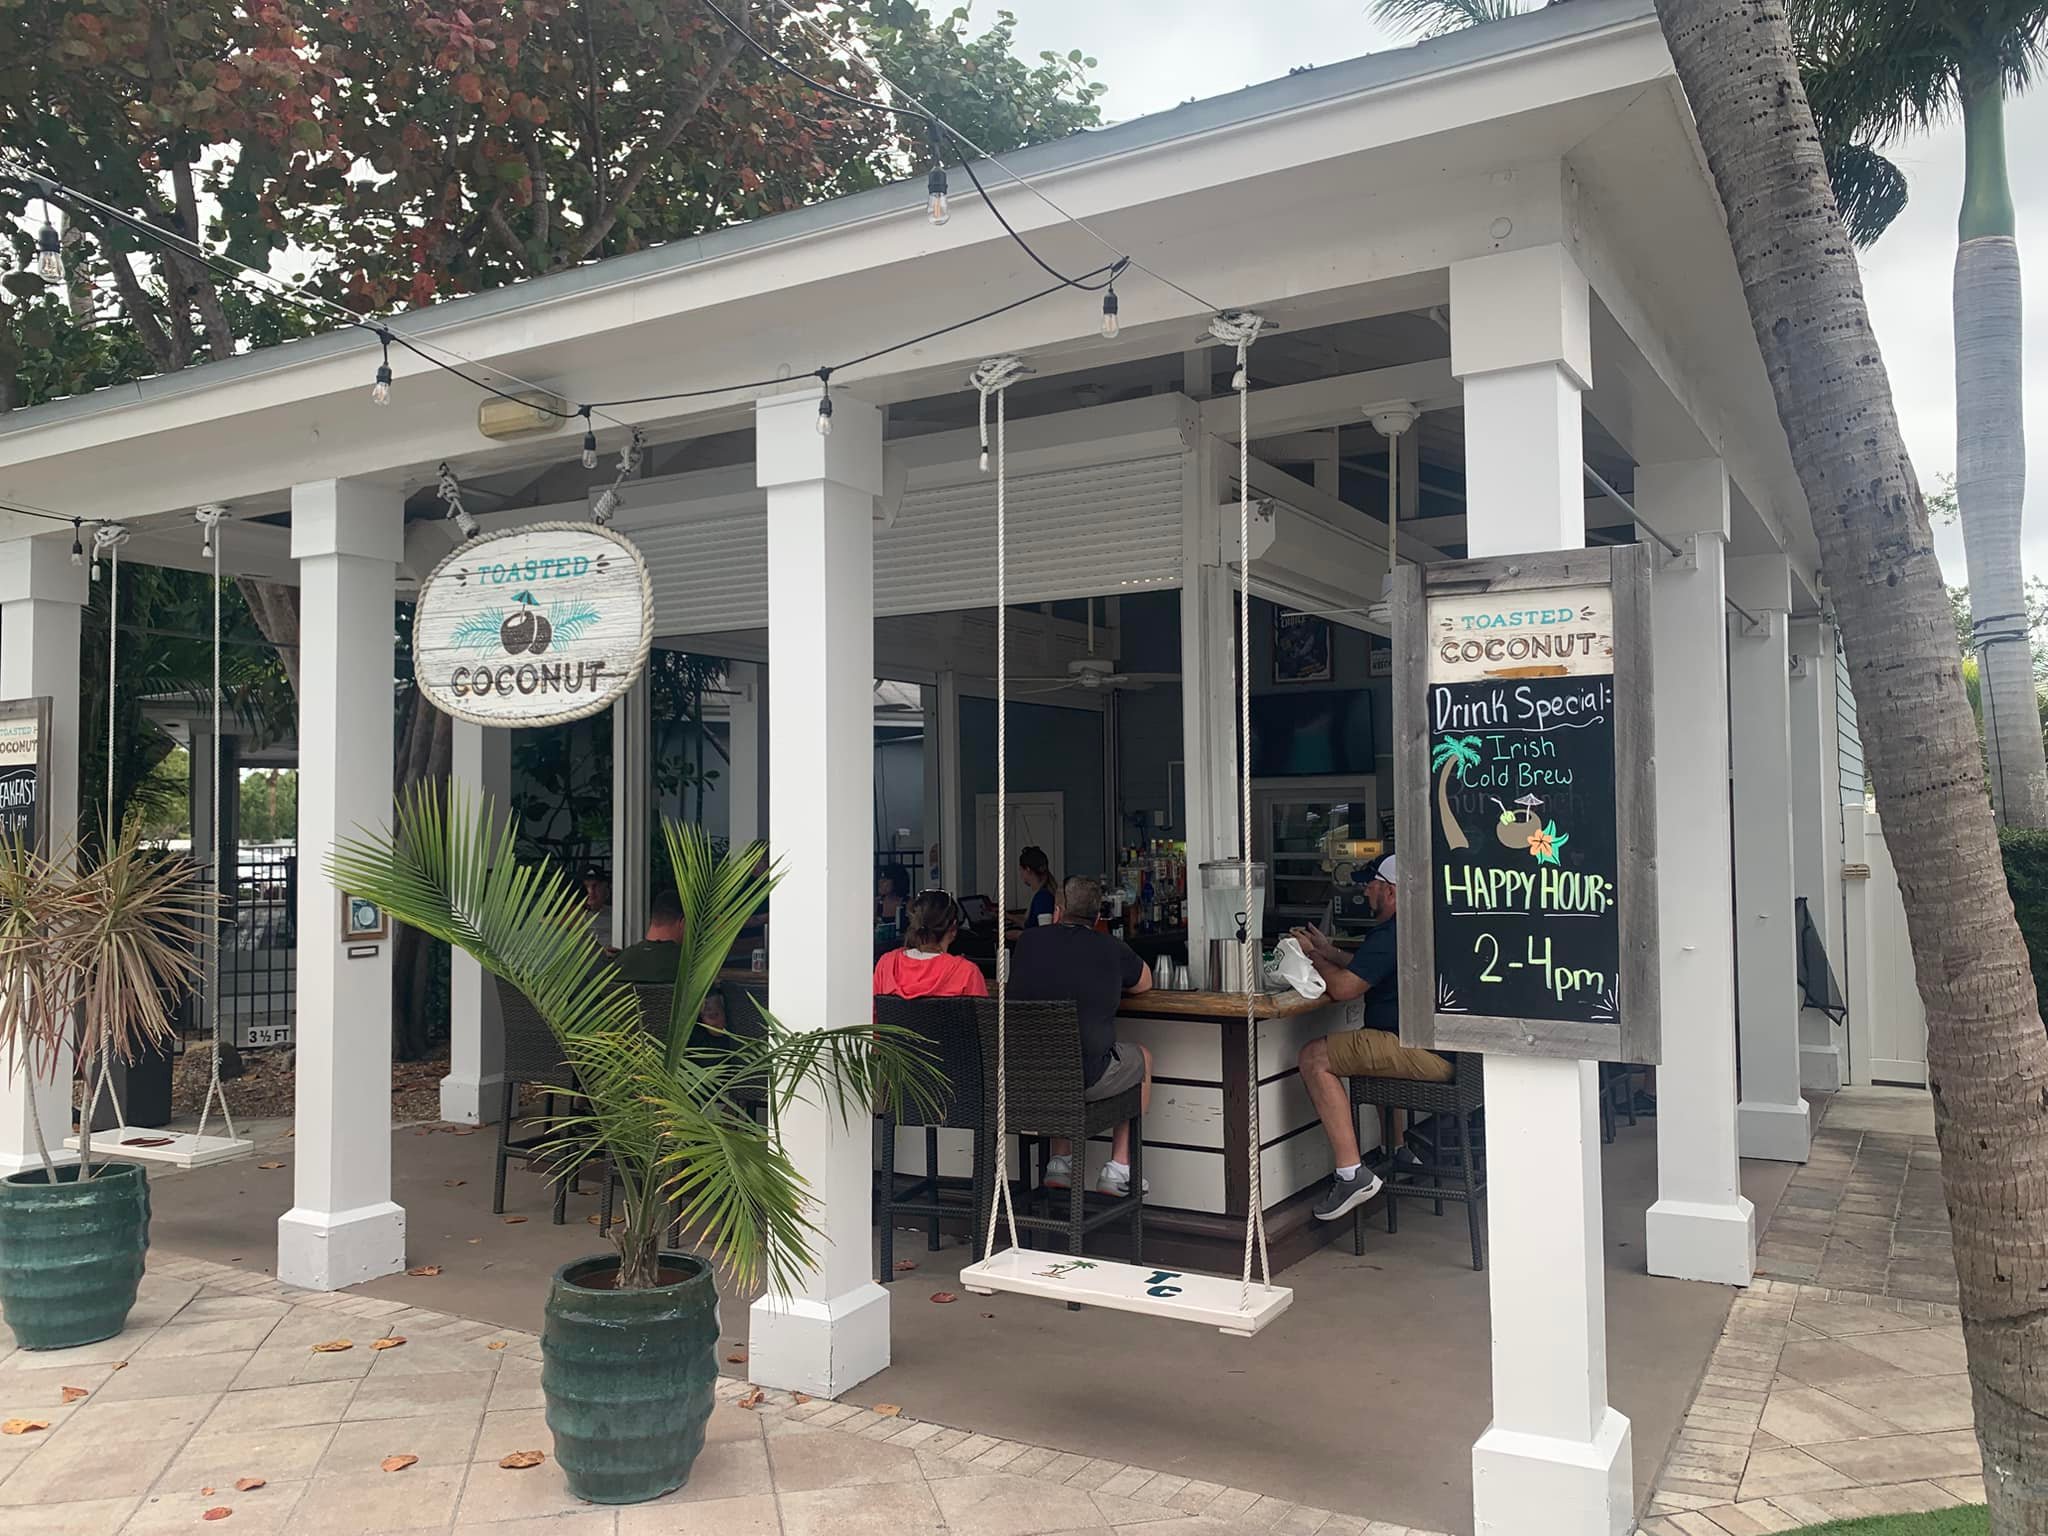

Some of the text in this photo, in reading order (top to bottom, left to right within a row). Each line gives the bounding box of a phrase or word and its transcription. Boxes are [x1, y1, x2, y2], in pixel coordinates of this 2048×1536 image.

[478, 556, 589, 585] TOASTED
[1461, 607, 1574, 631] TOASTED
[1440, 632, 1597, 664] COCONUT
[450, 660, 606, 698] COCONUT
[1434, 682, 1613, 731] Drink Special:
[1486, 734, 1556, 761] Irish
[1463, 763, 1574, 788] Cold Brew
[1443, 864, 1614, 913] HAPPY HOUR:
[274, 1029, 289, 1041] FT
